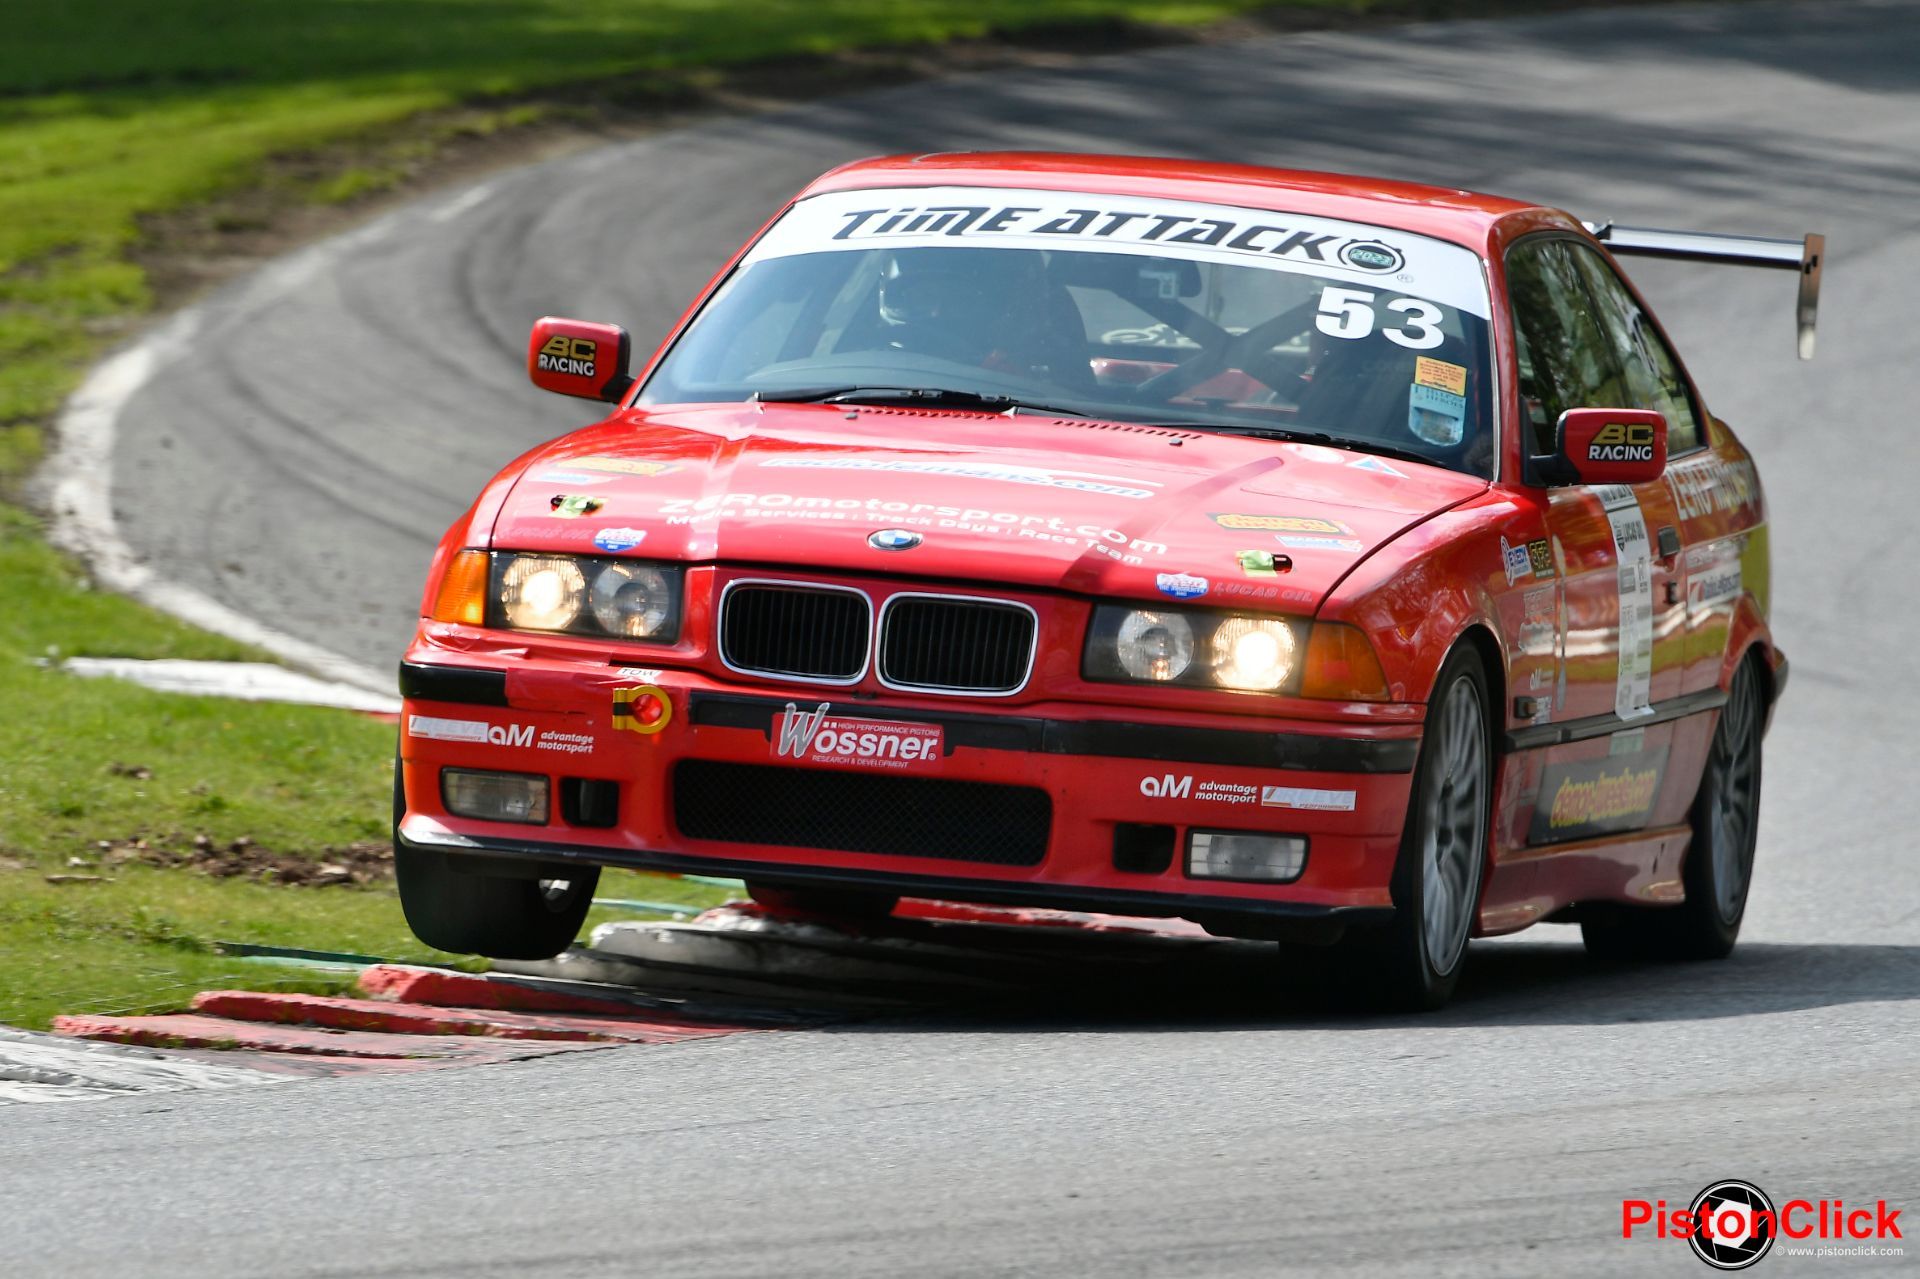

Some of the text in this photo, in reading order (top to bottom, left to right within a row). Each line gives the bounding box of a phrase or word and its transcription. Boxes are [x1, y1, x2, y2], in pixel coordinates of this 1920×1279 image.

[1030, 208, 1341, 262] ATTACK
[1316, 286, 1444, 350] 53
[541, 335, 596, 361] BC
[538, 353, 595, 377] RACING
[1591, 424, 1654, 445] BC
[1588, 445, 1653, 461] RACING
[743, 508, 846, 520] Services
[867, 512, 932, 526] Track
[939, 518, 1000, 533] Days
[1019, 529, 1078, 546] Race
[1087, 538, 1145, 565] Team
[621, 667, 656, 677] TOW
[540, 730, 594, 745] advantage
[855, 724, 909, 735] PERFORMANCE
[909, 727, 941, 737] PISTONS
[537, 741, 594, 755] motorsport
[811, 754, 850, 764] RESEARCH
[856, 758, 909, 770] DEVELOPMENT
[1199, 781, 1258, 795] advantage
[1195, 791, 1257, 804] motorsport
